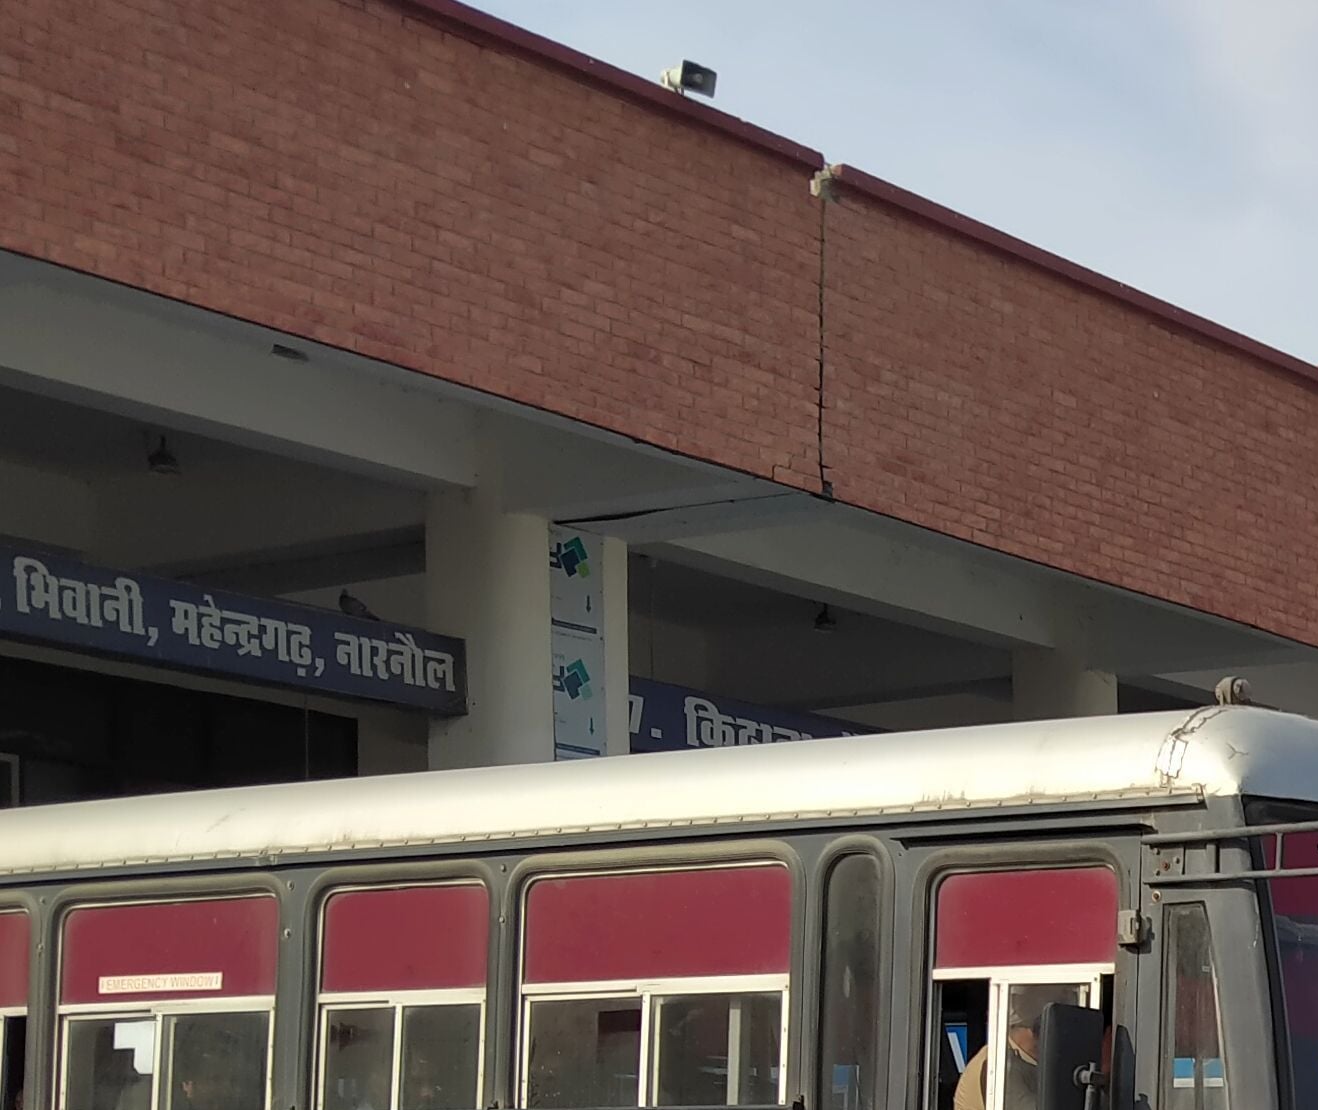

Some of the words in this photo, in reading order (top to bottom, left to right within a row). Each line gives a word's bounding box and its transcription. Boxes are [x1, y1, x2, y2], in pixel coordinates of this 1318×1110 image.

[13, 556, 158, 647] भिवानी,
[169, 594, 325, 677] महेन्द्रगढ़,
[333, 631, 456, 692] नारनौल
[105, 978, 168, 992] EMERGENCY
[170, 974, 214, 989] WINDOW
